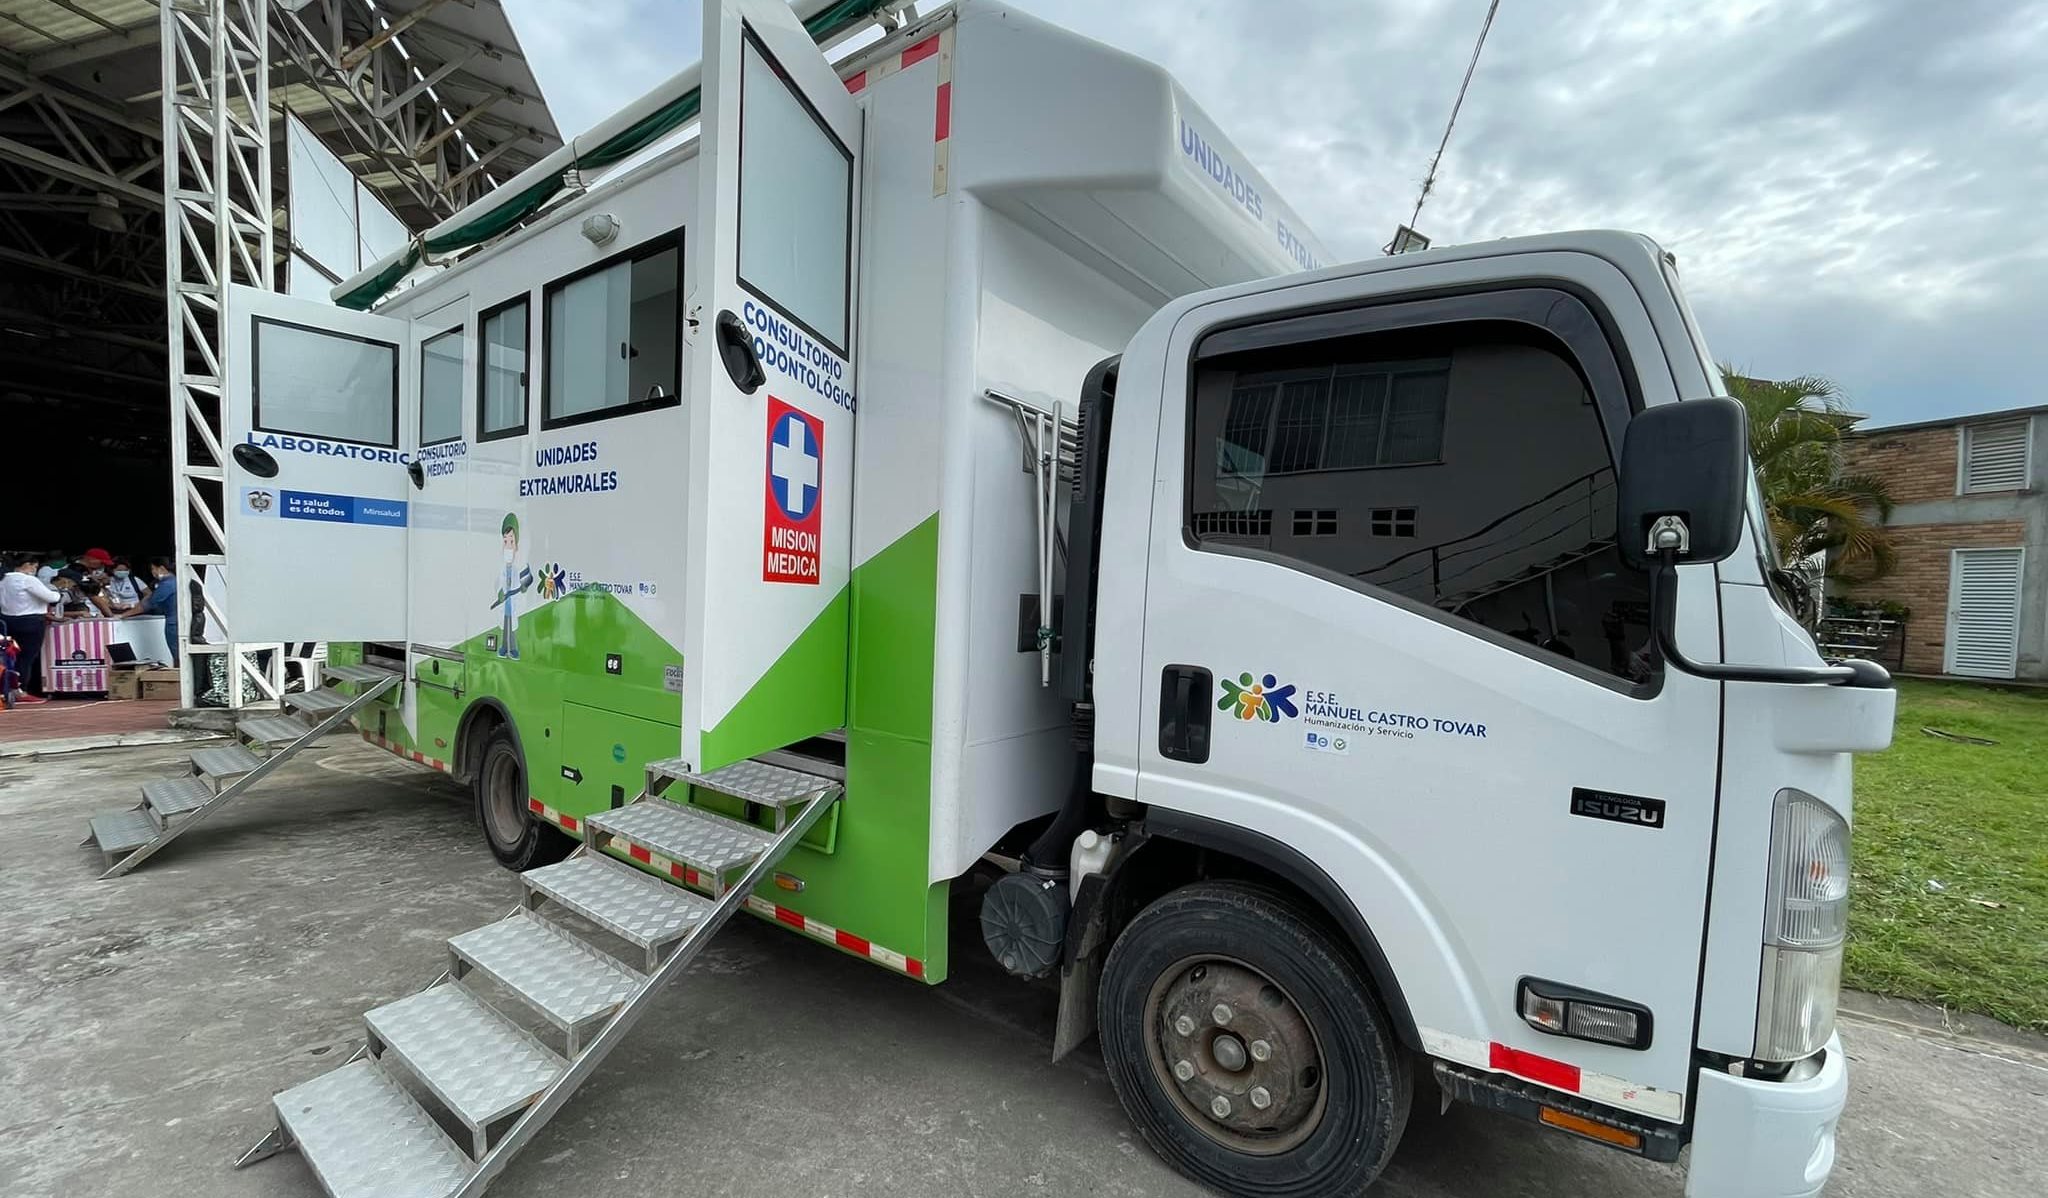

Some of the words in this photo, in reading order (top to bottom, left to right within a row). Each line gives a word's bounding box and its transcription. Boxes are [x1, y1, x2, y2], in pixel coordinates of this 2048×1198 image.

[1181, 119, 1263, 221] UNIDADES
[1277, 219, 1320, 270] EXTRA
[744, 301, 842, 380] CONSULTORIO
[753, 336, 856, 415] ODONTOLÓGICO
[417, 442, 467, 460] CONSULTORIO
[536, 442, 597, 467] UNIDADES
[520, 471, 617, 496] EXTRAMURALES
[303, 498, 329, 507] salud
[303, 506, 316, 514] de
[318, 508, 345, 516] todos
[363, 508, 400, 517] Minsalud
[772, 526, 816, 553] MISION
[767, 552, 817, 577] MEDICA
[1306, 690, 1338, 705] E.S.E.
[1304, 717, 1366, 732] Humanización
[1367, 727, 1374, 735] y
[1377, 726, 1414, 739] Servicio
[1305, 703, 1364, 722] MANUEL
[1367, 711, 1429, 731] CASTRO
[1433, 719, 1487, 738] TOVAR
[1577, 800, 1658, 823] ISUZU
